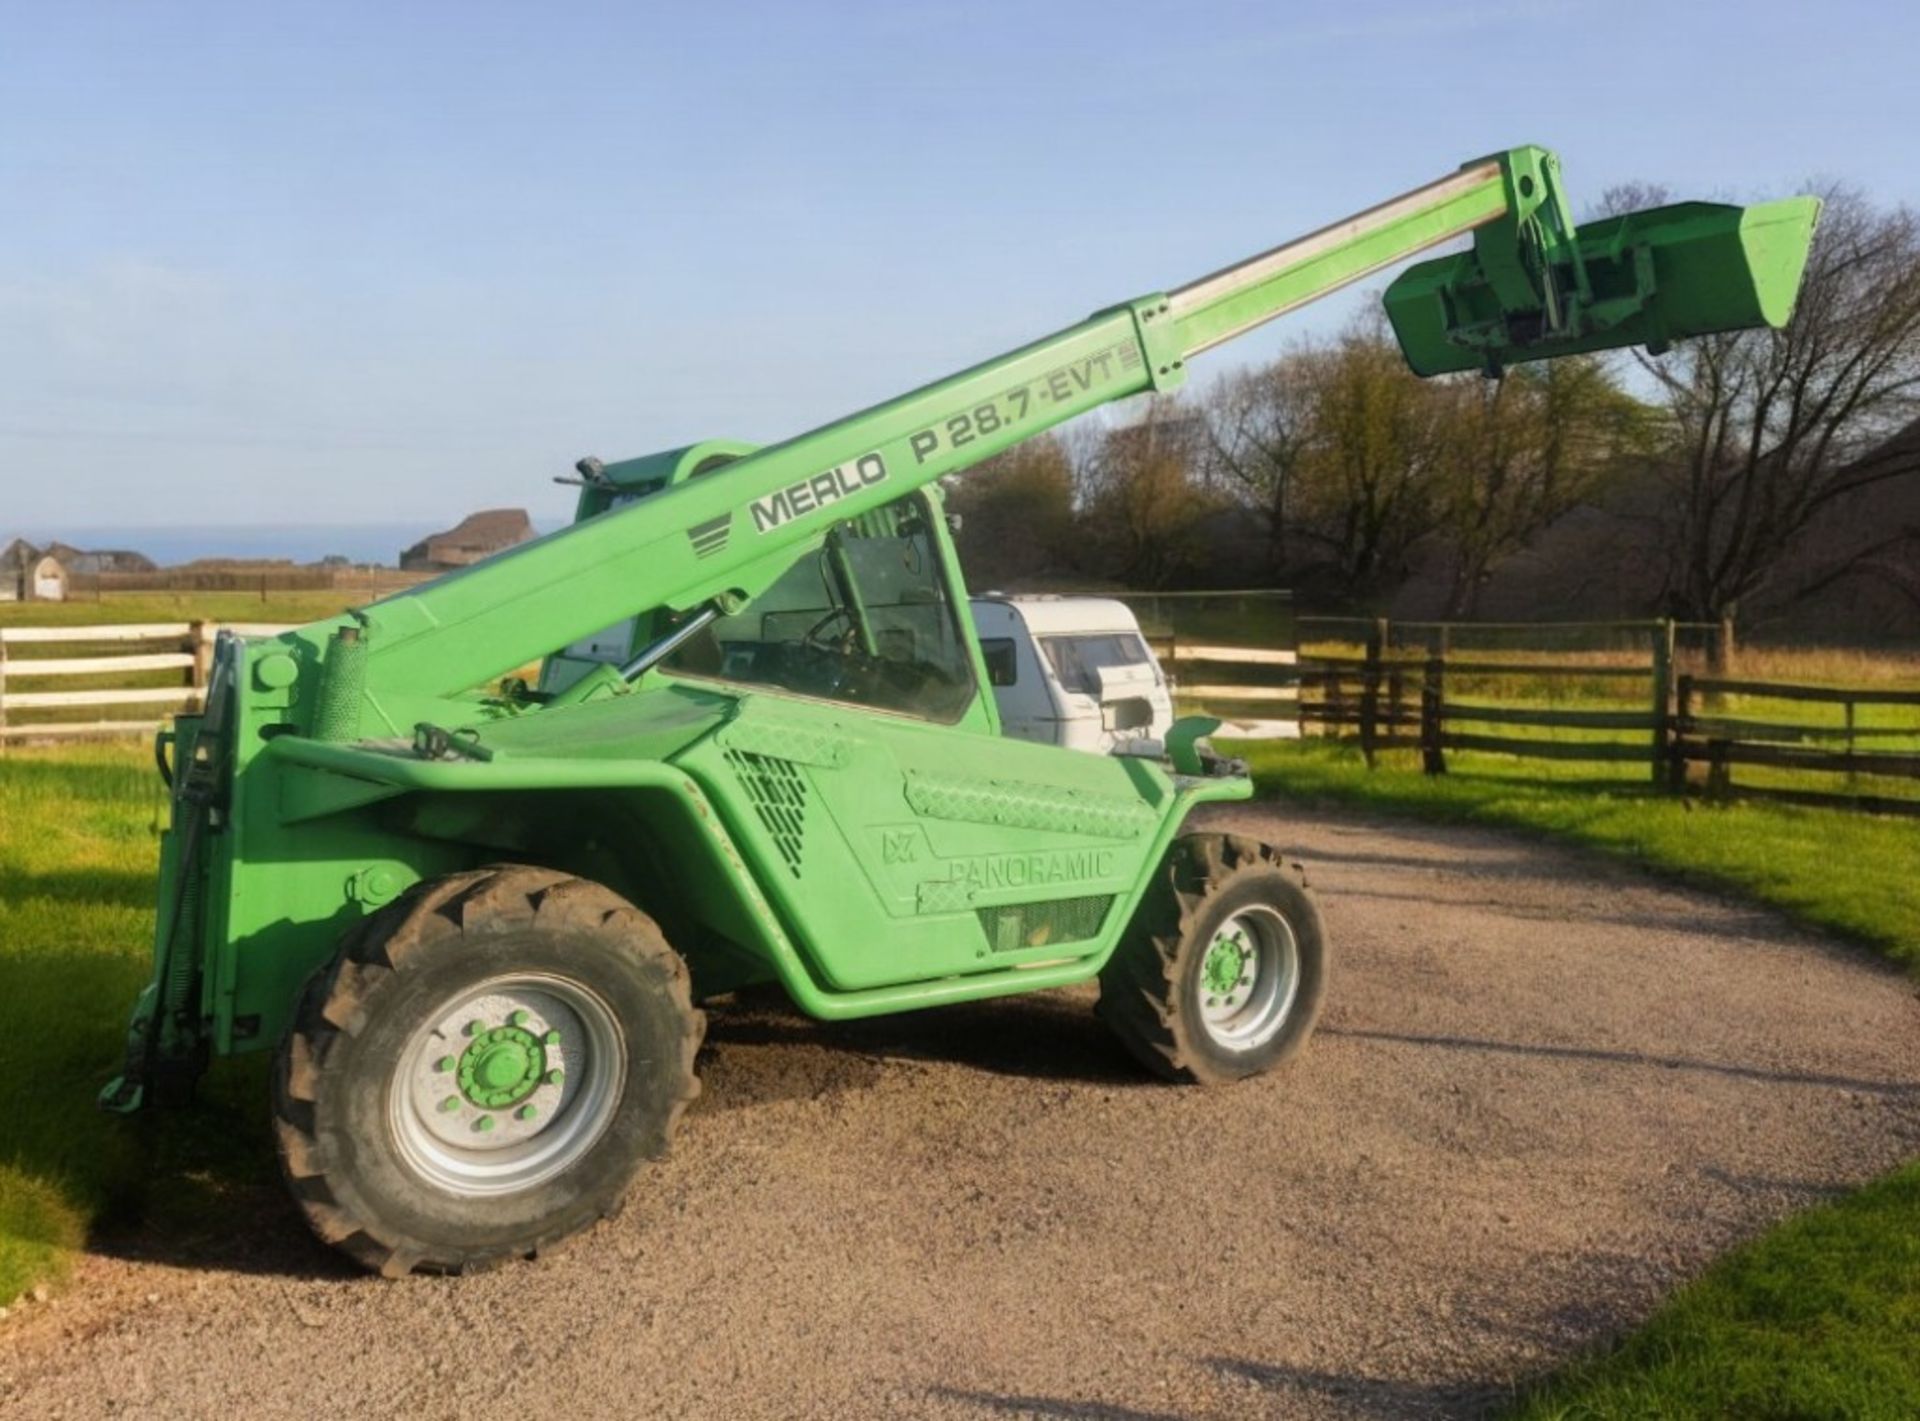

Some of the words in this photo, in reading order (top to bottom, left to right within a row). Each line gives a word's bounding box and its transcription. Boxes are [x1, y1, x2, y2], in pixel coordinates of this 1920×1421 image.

[750, 453, 887, 532] MERLO
[910, 431, 939, 465] P
[949, 850, 1113, 889] PANORAMIC
